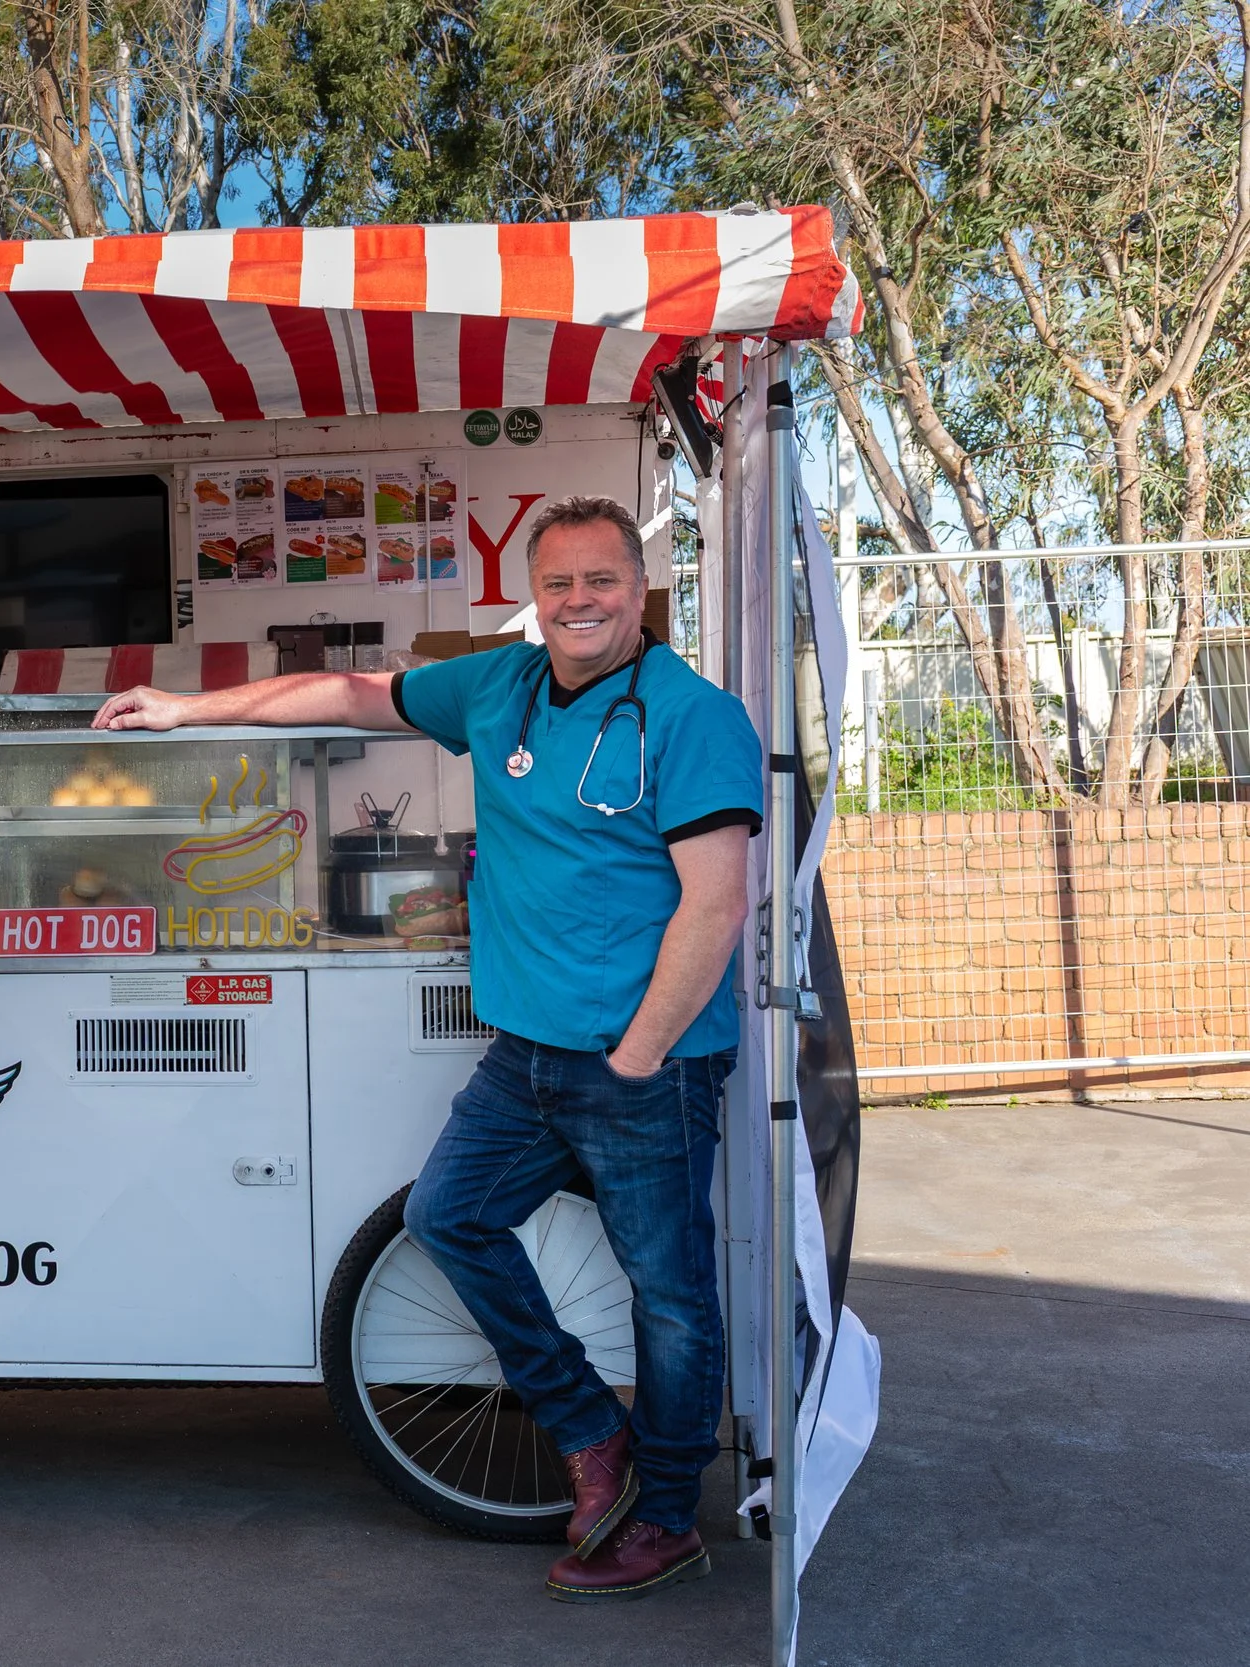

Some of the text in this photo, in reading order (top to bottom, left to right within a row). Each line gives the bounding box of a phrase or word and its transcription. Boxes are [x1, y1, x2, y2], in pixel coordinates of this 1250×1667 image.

[465, 423, 499, 432] FETTAYLEH
[509, 415, 539, 431] حلال
[468, 494, 545, 606] Y
[2, 916, 64, 950] HOT
[80, 914, 142, 949] DOG
[218, 979, 267, 989] L.P. GAS
[217, 991, 268, 1001] STORAGE
